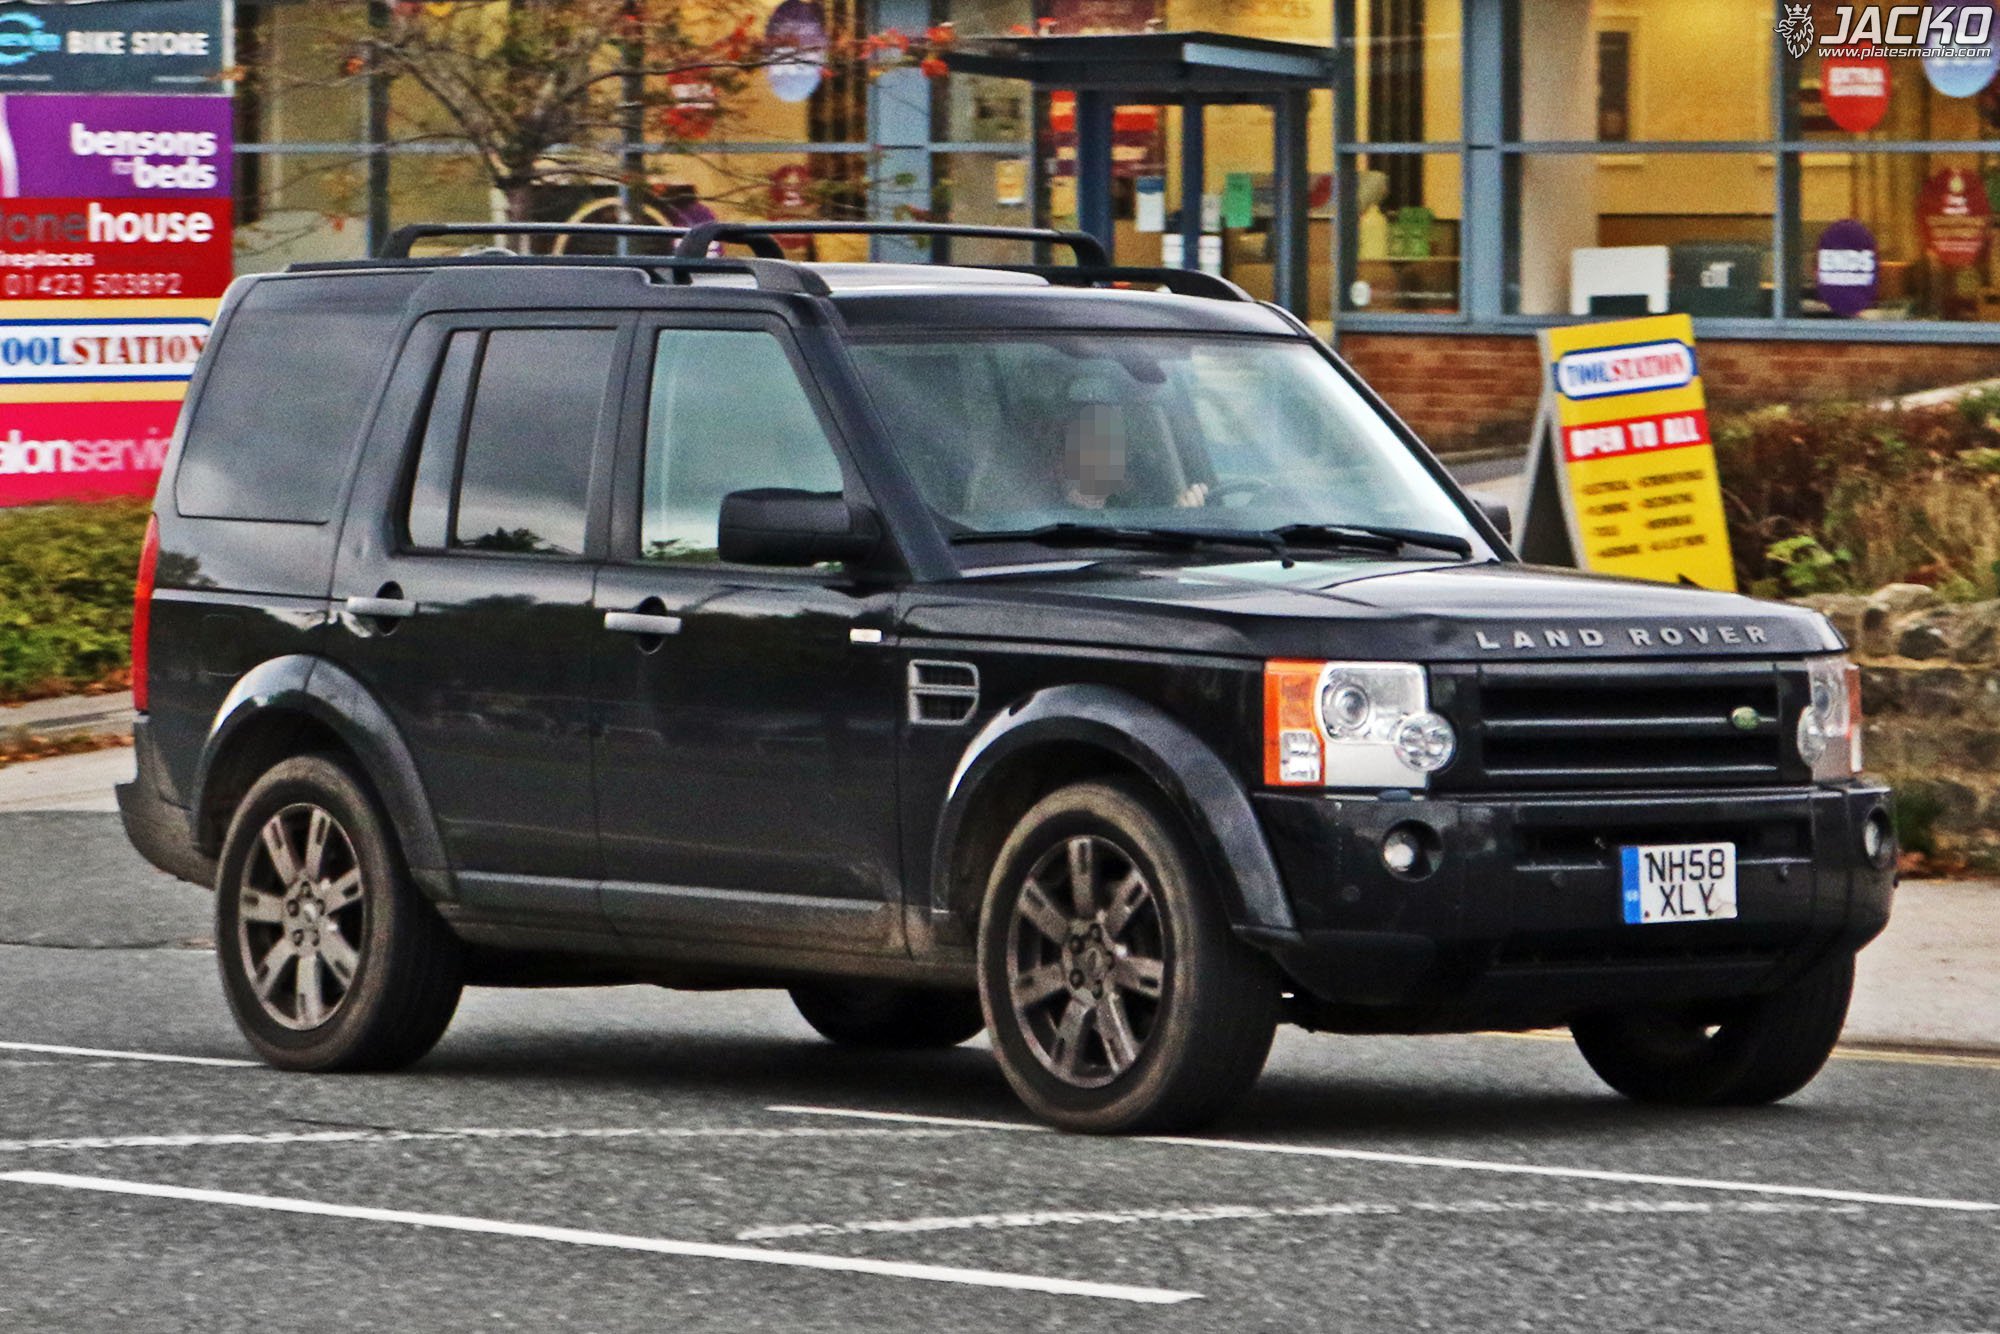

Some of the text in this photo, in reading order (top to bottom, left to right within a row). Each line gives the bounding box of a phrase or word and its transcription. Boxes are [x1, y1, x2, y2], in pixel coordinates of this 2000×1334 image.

[66, 31, 126, 54] BIKE
[131, 32, 209, 55] STORE
[71, 122, 217, 156] bensons
[133, 156, 217, 188] beds
[0, 202, 214, 242] onehouse
[4, 273, 84, 295] 01423
[0, 335, 209, 365] OOLSTATION
[1569, 416, 1701, 457] OPEN TO ALL
[1475, 625, 1768, 650] LAND ROVER
[1646, 849, 1725, 883] NH58
[1660, 883, 1716, 917] XLY
